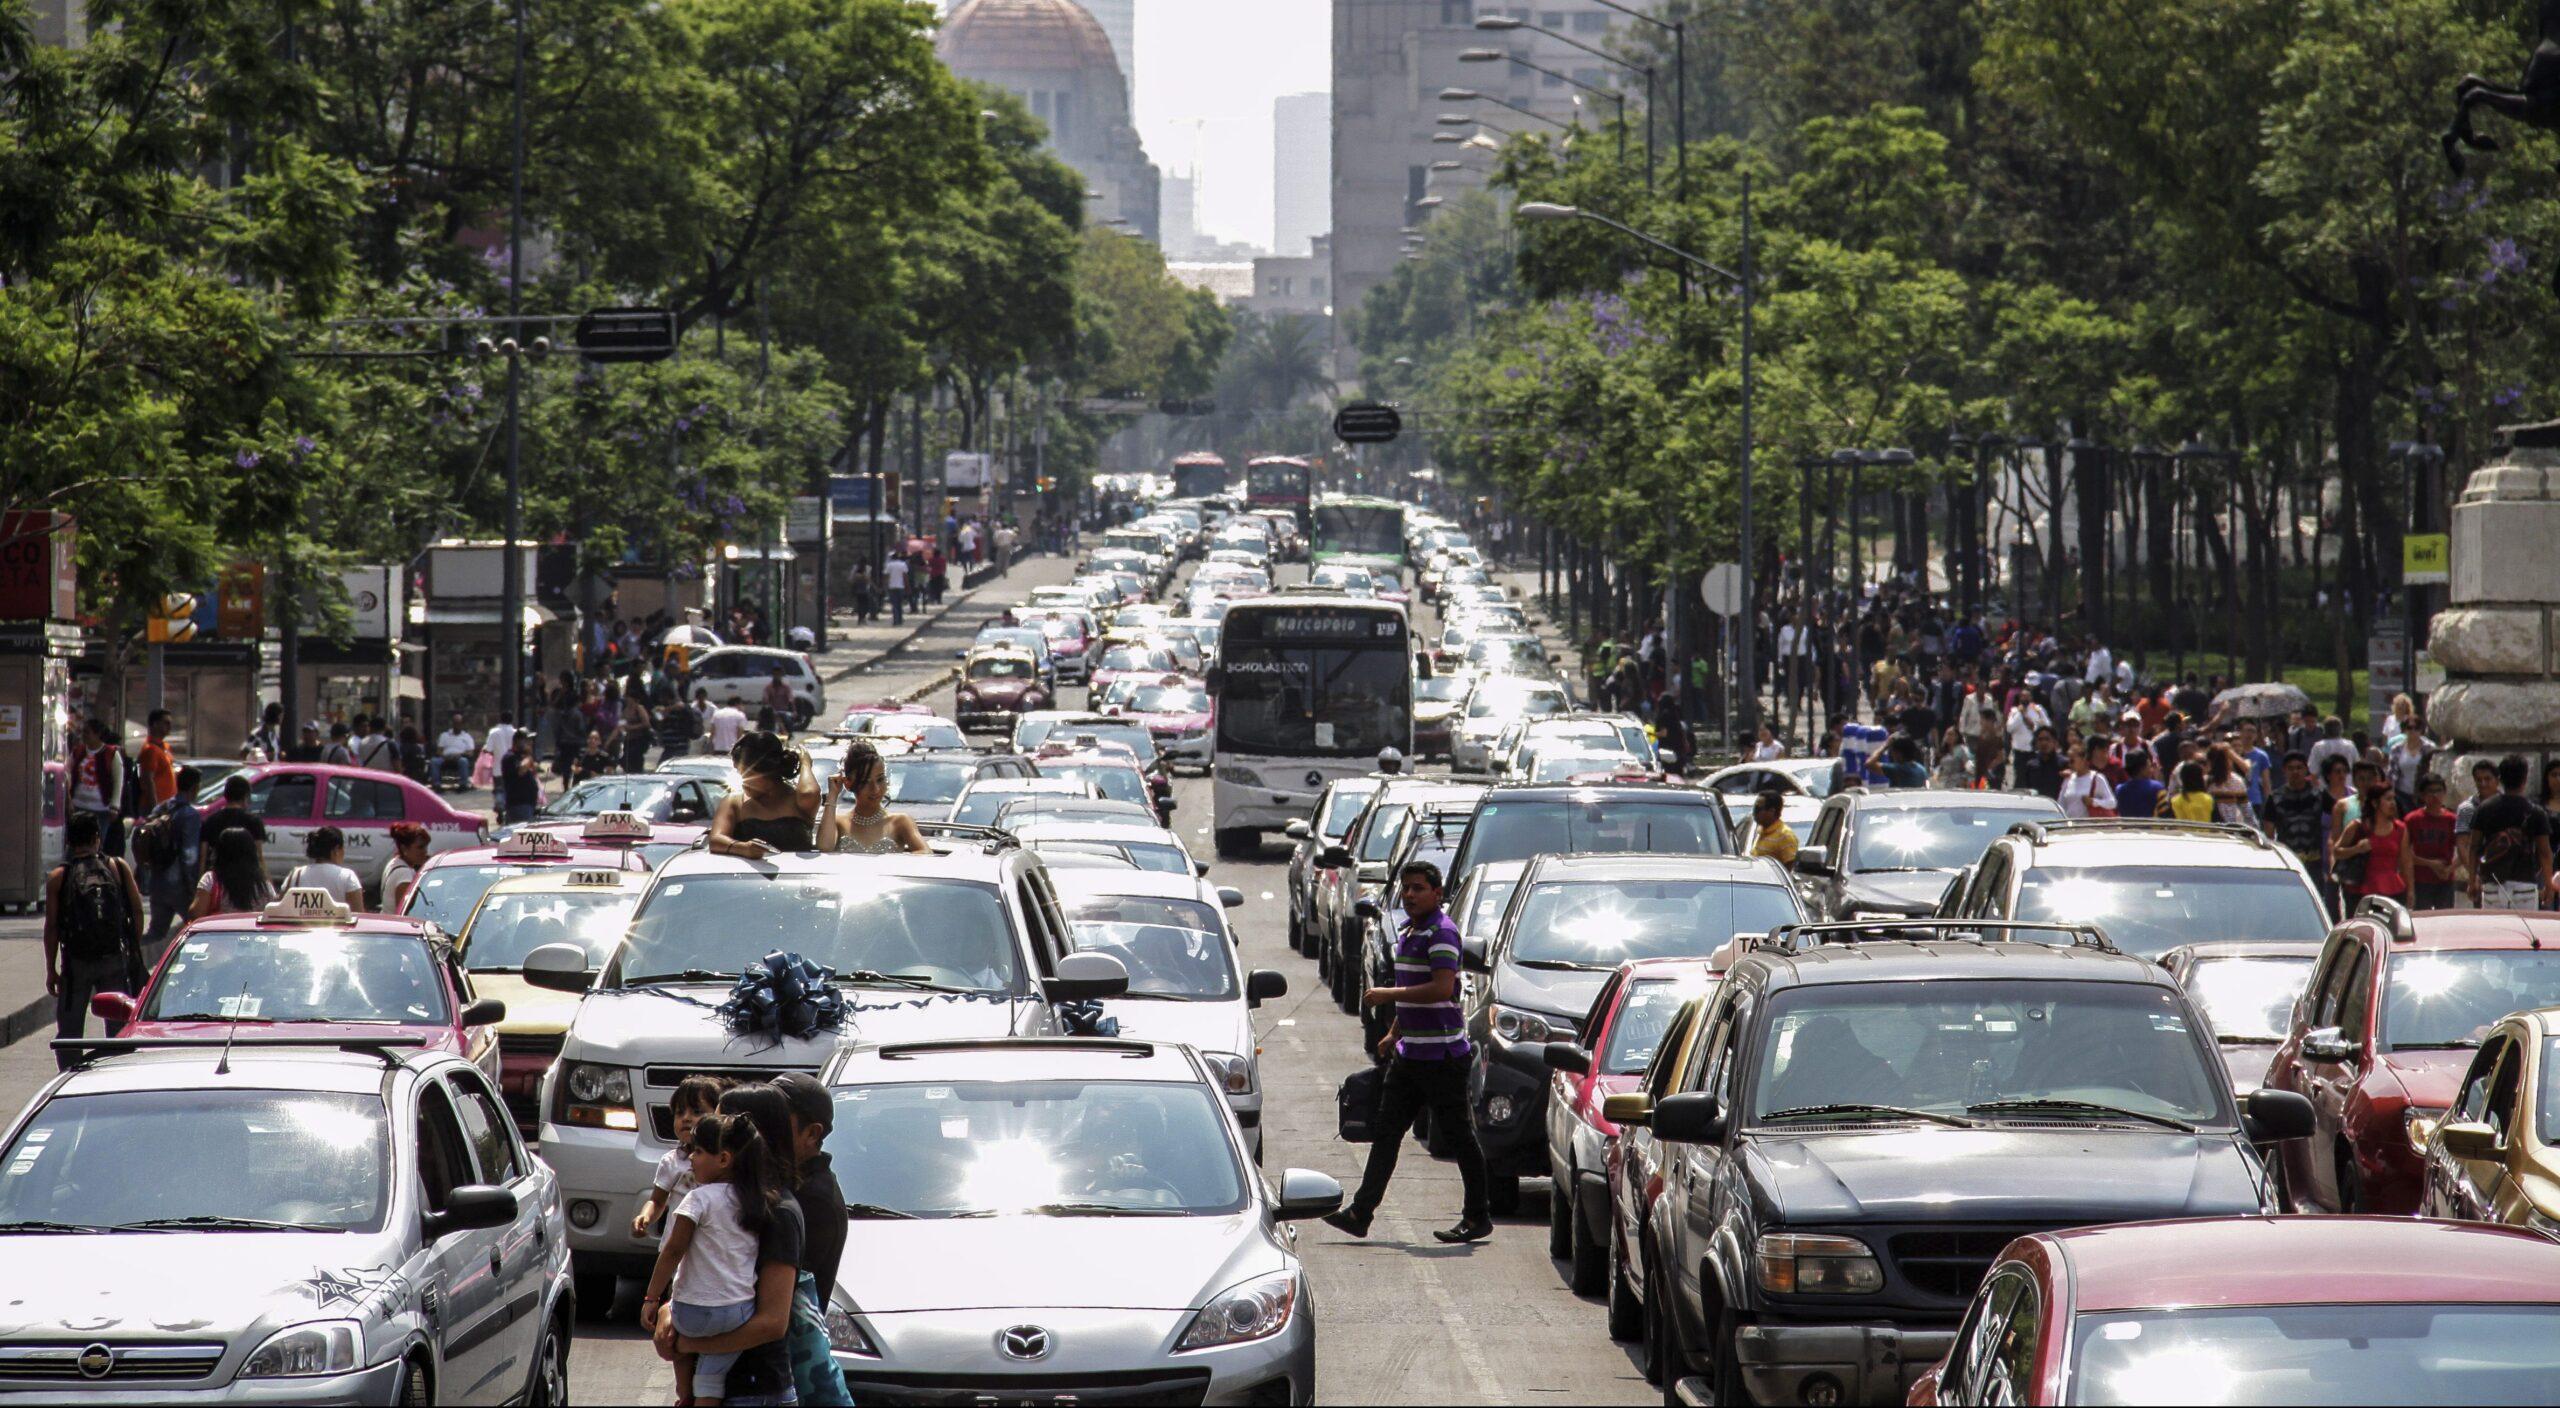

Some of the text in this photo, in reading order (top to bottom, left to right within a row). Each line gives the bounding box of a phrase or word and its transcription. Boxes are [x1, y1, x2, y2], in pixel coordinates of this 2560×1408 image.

[602, 813, 631, 825] TAXI
[518, 832, 549, 845] TAXI
[577, 872, 611, 884] TAXI
[292, 892, 324, 909] TAXI
[300, 909, 323, 917] LIBRE
[1739, 937, 1768, 954] TA
